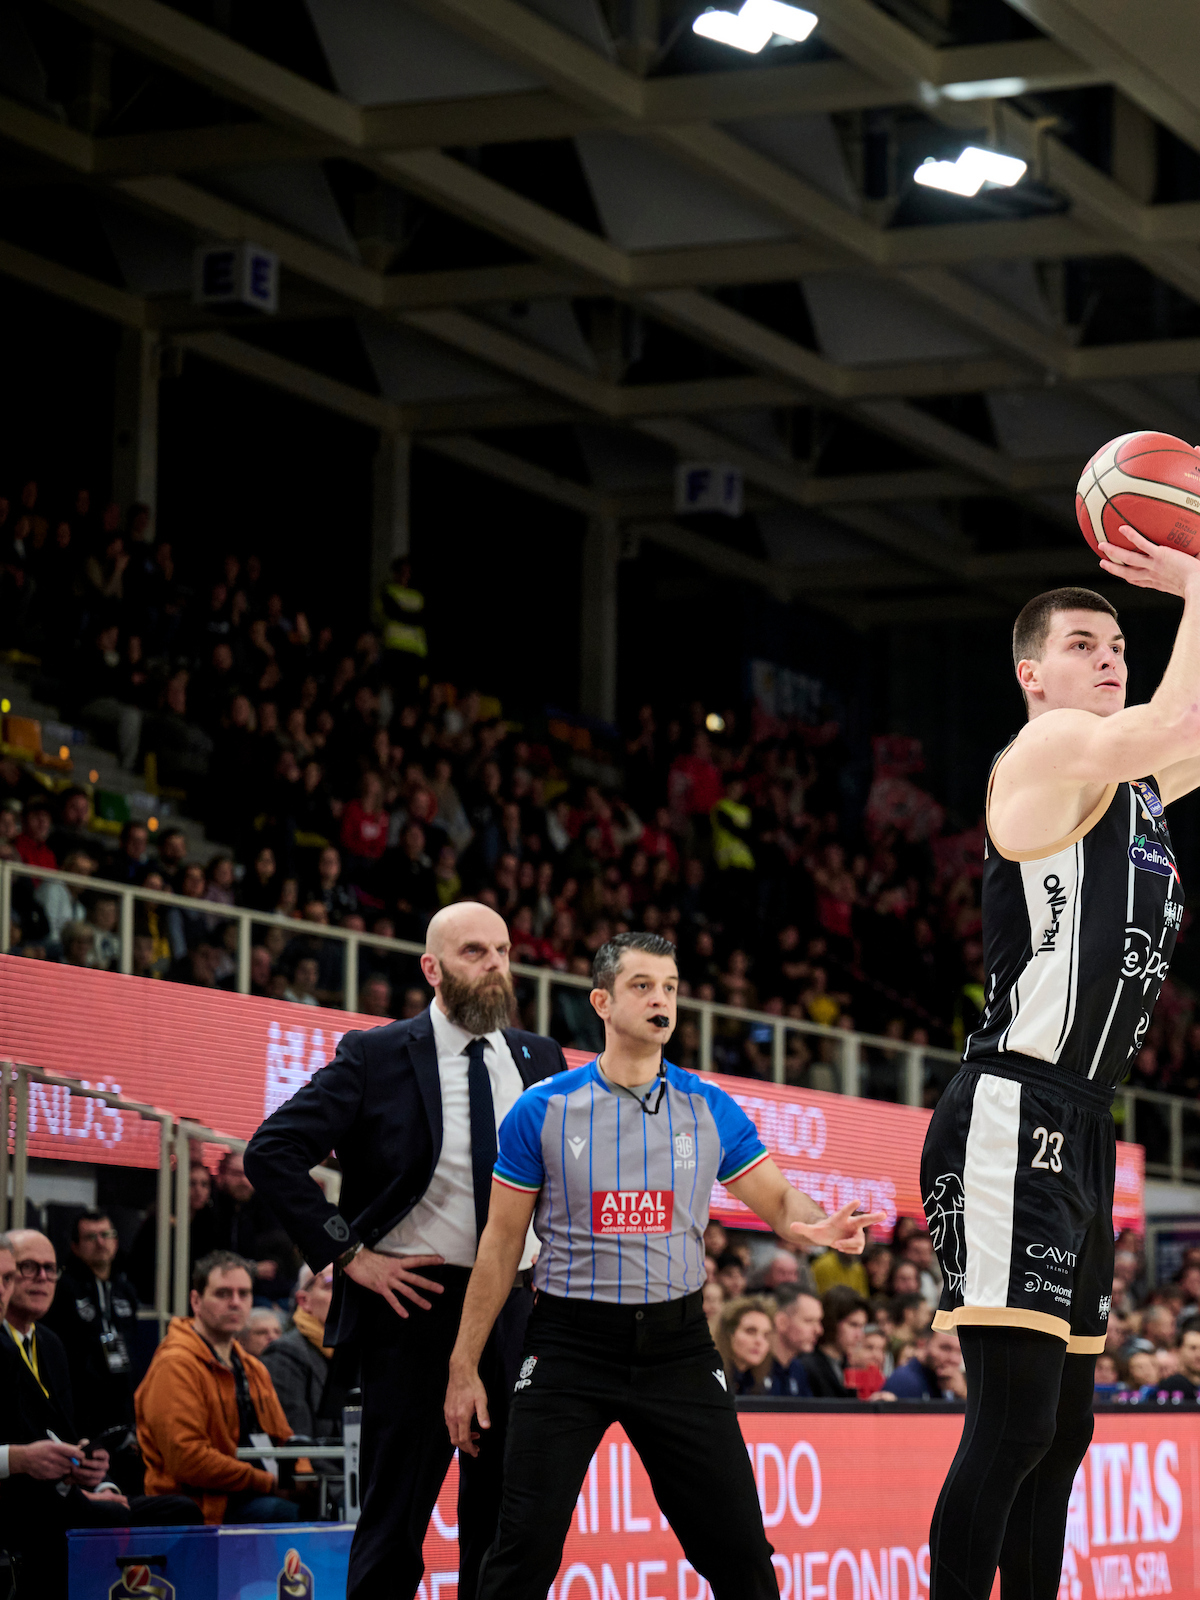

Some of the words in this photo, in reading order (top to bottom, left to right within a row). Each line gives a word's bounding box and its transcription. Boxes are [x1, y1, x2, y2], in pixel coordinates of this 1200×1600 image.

[205, 253, 233, 294] E
[1167, 528, 1194, 549] FIBA
[1031, 1126, 1064, 1173] 23
[674, 1160, 696, 1169] FIP
[601, 1192, 665, 1211] ATTAL
[601, 1212, 665, 1225] GROUP
[643, 1224, 665, 1232] LAVORO
[1046, 1264, 1068, 1275] TRENTO
[609, 1443, 651, 1533] IL
[1090, 1439, 1183, 1546] ITAS
[1091, 1554, 1136, 1600] VITA
[1134, 1551, 1173, 1598] SPA
